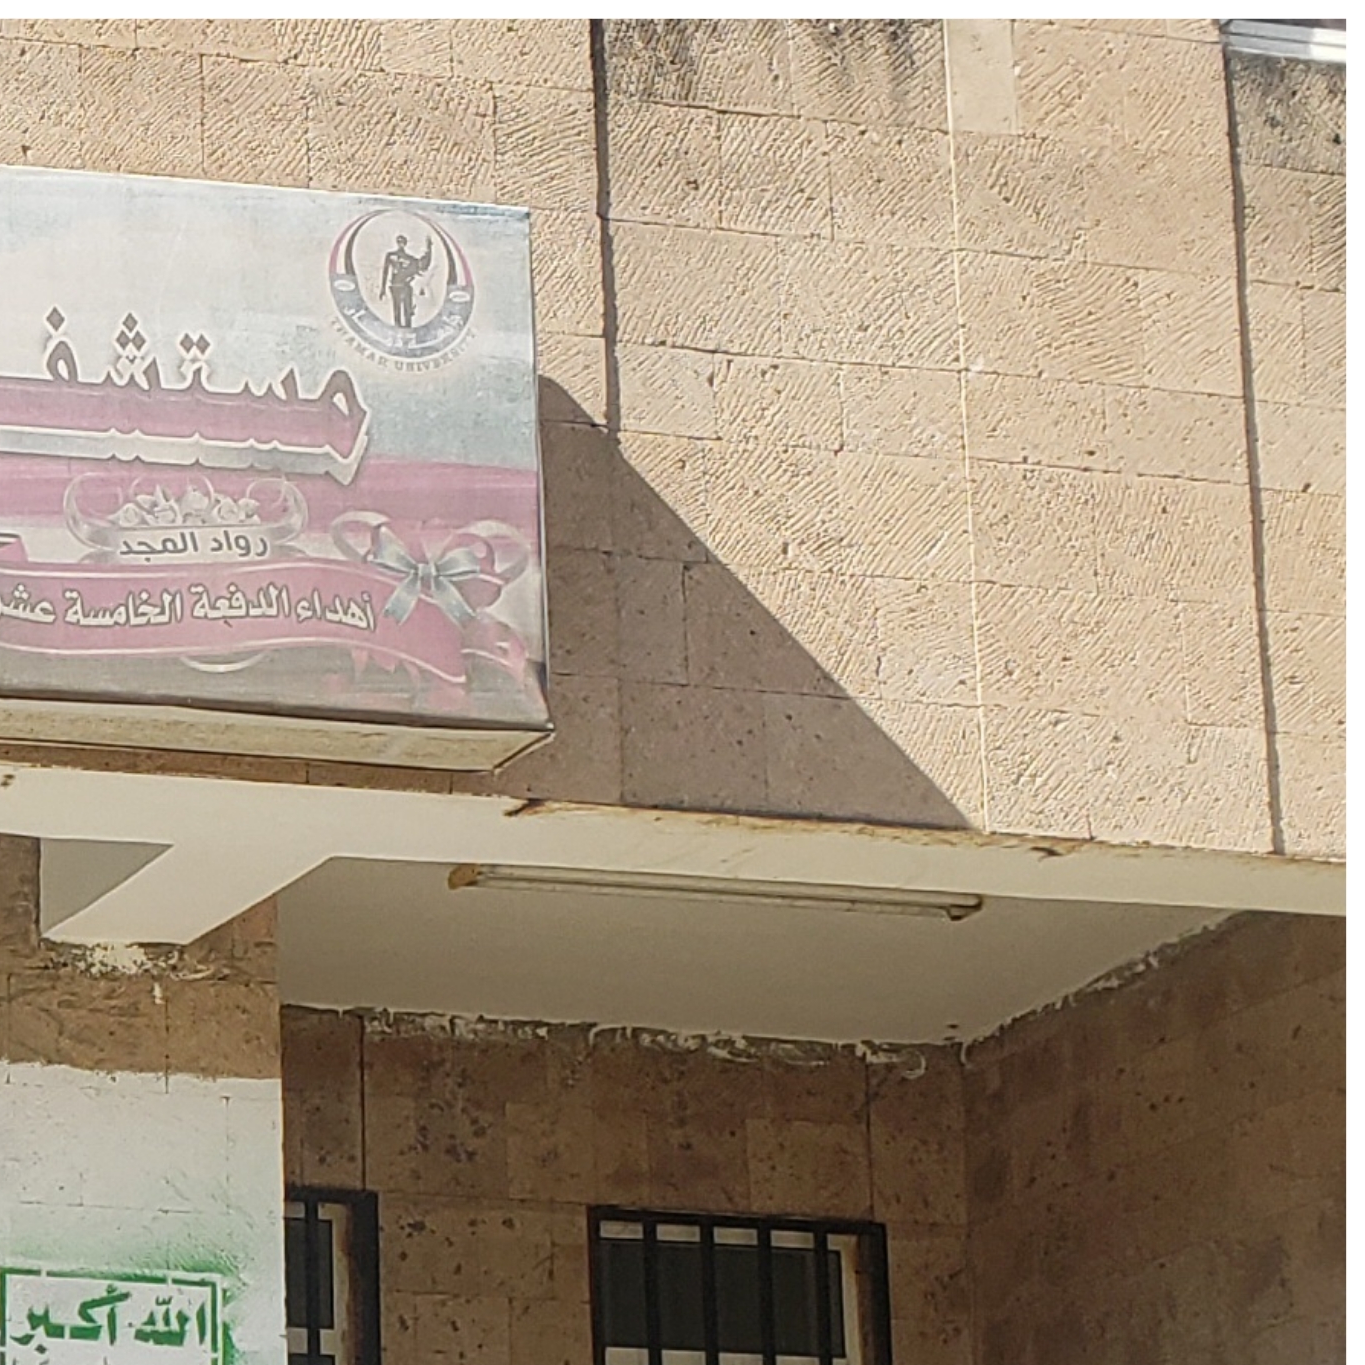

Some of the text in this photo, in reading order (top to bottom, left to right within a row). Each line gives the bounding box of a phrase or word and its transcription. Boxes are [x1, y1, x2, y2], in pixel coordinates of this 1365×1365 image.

[119, 530, 268, 562] رواد المجد
[63, 587, 185, 629] الخامسة
[188, 580, 291, 630] الدفعة
